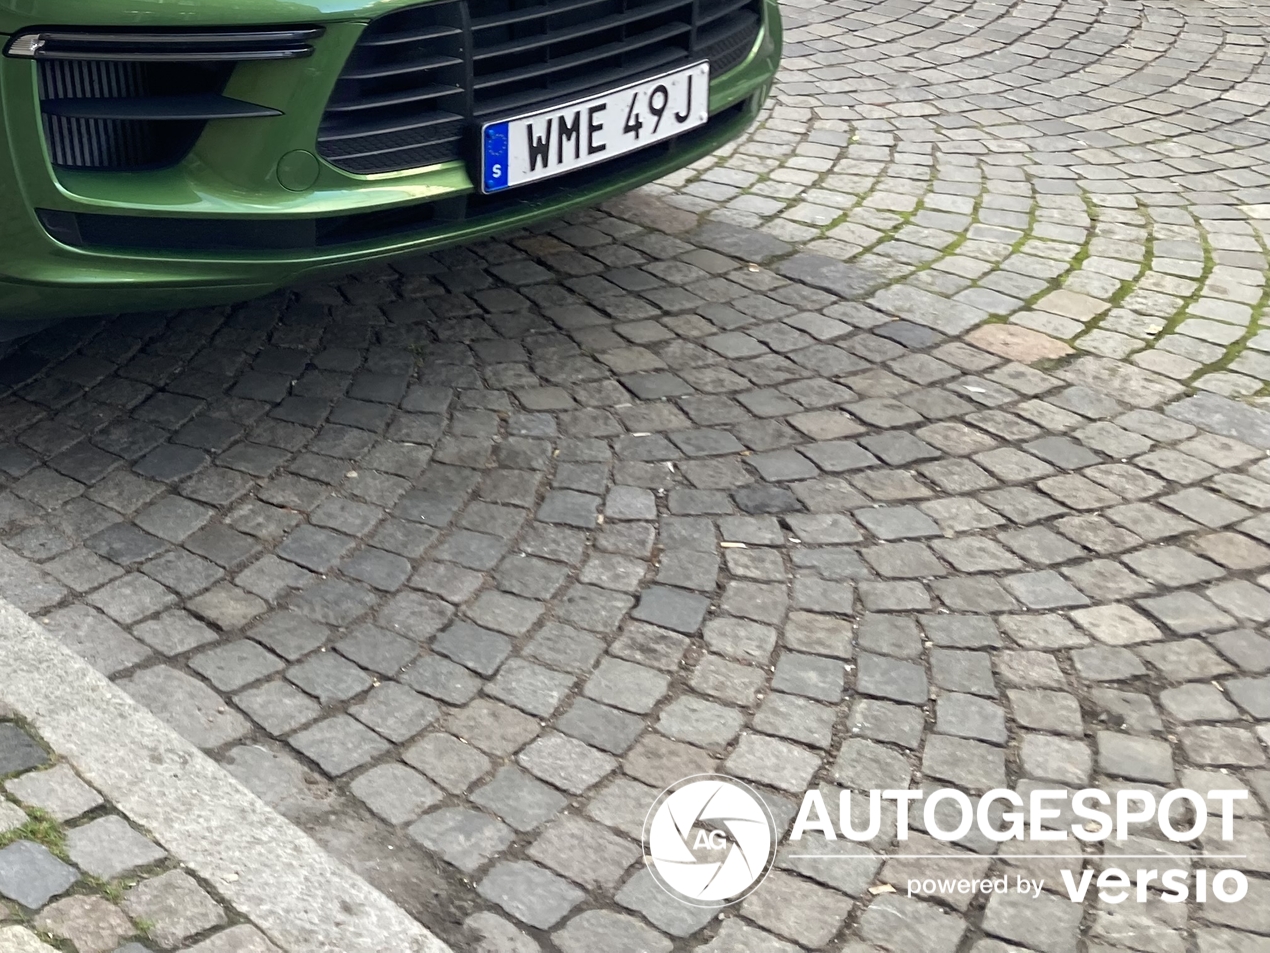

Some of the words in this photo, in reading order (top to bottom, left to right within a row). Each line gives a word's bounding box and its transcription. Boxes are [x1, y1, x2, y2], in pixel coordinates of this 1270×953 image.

[526, 102, 607, 172] WME
[622, 74, 693, 140] 49J
[492, 164, 502, 178] S
